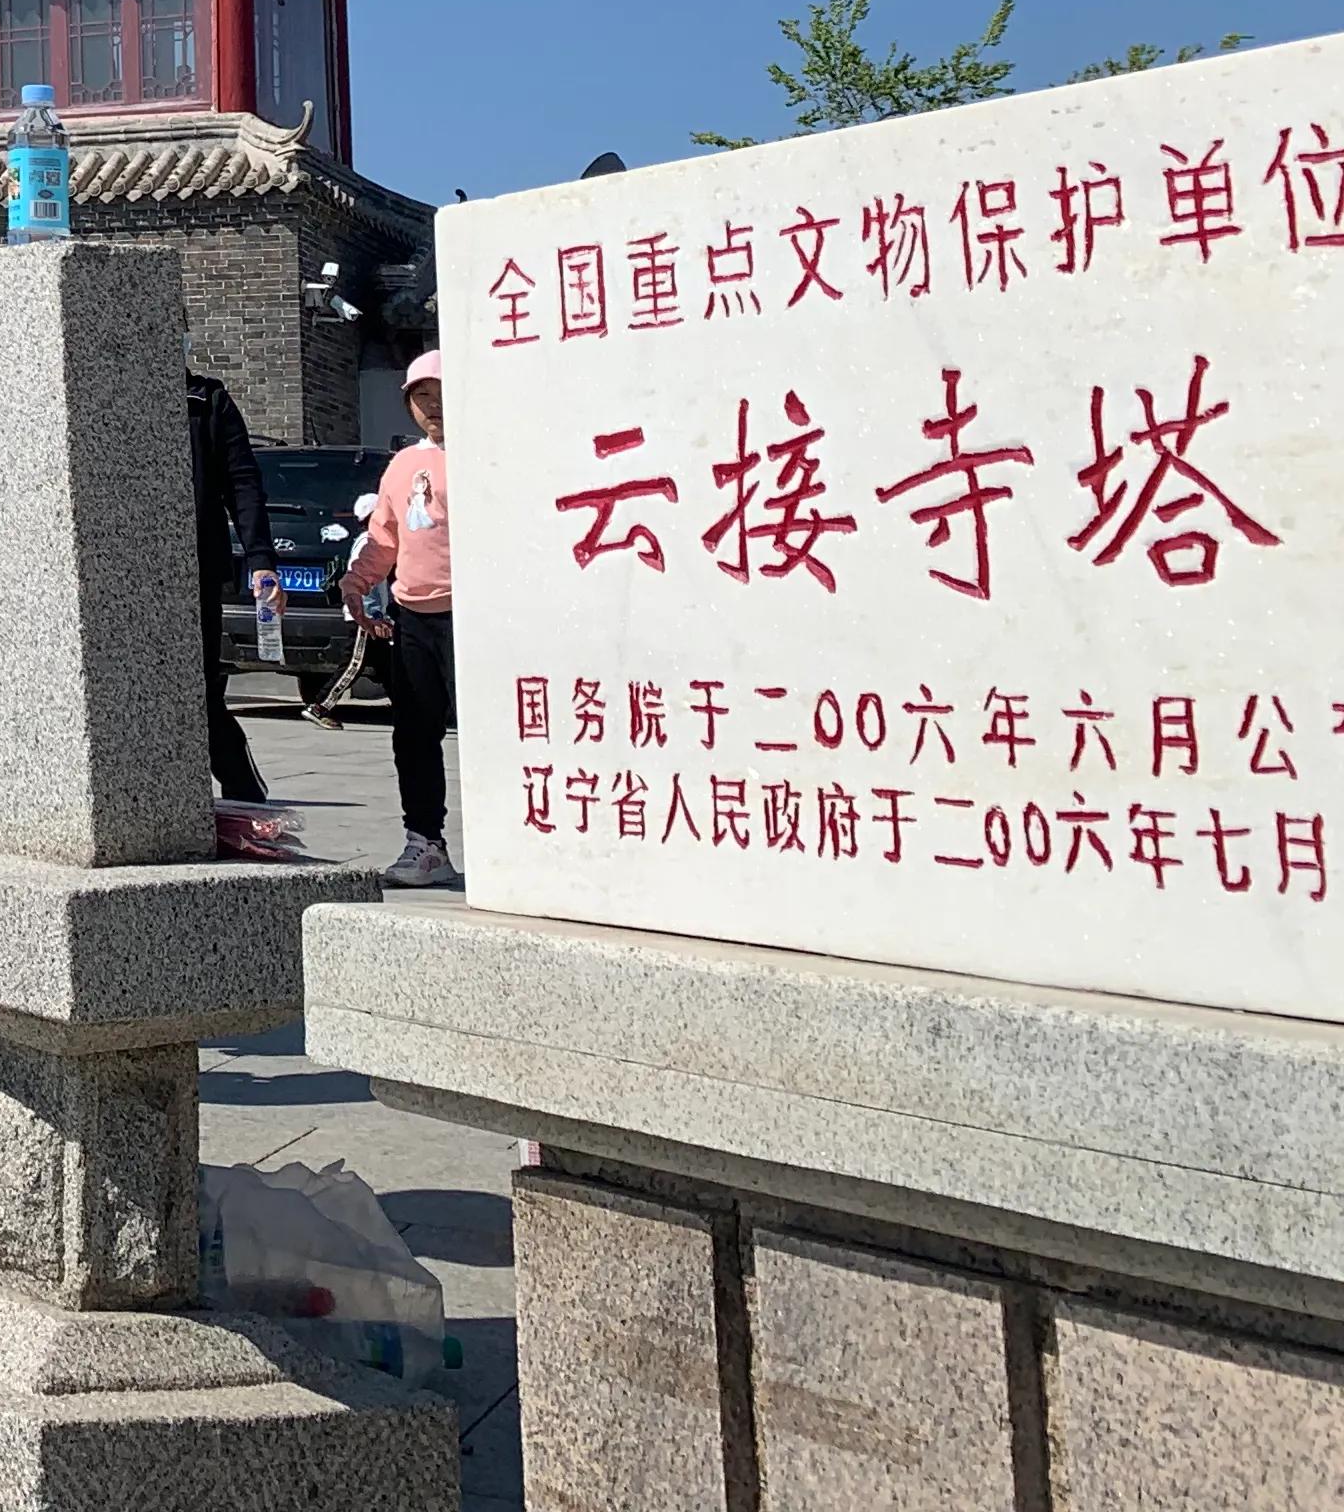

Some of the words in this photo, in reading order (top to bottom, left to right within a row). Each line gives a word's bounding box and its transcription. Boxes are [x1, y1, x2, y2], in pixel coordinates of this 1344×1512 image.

[489, 122, 1344, 348] 全国重点文物保护单位
[555, 354, 1282, 600] 云接寺塔
